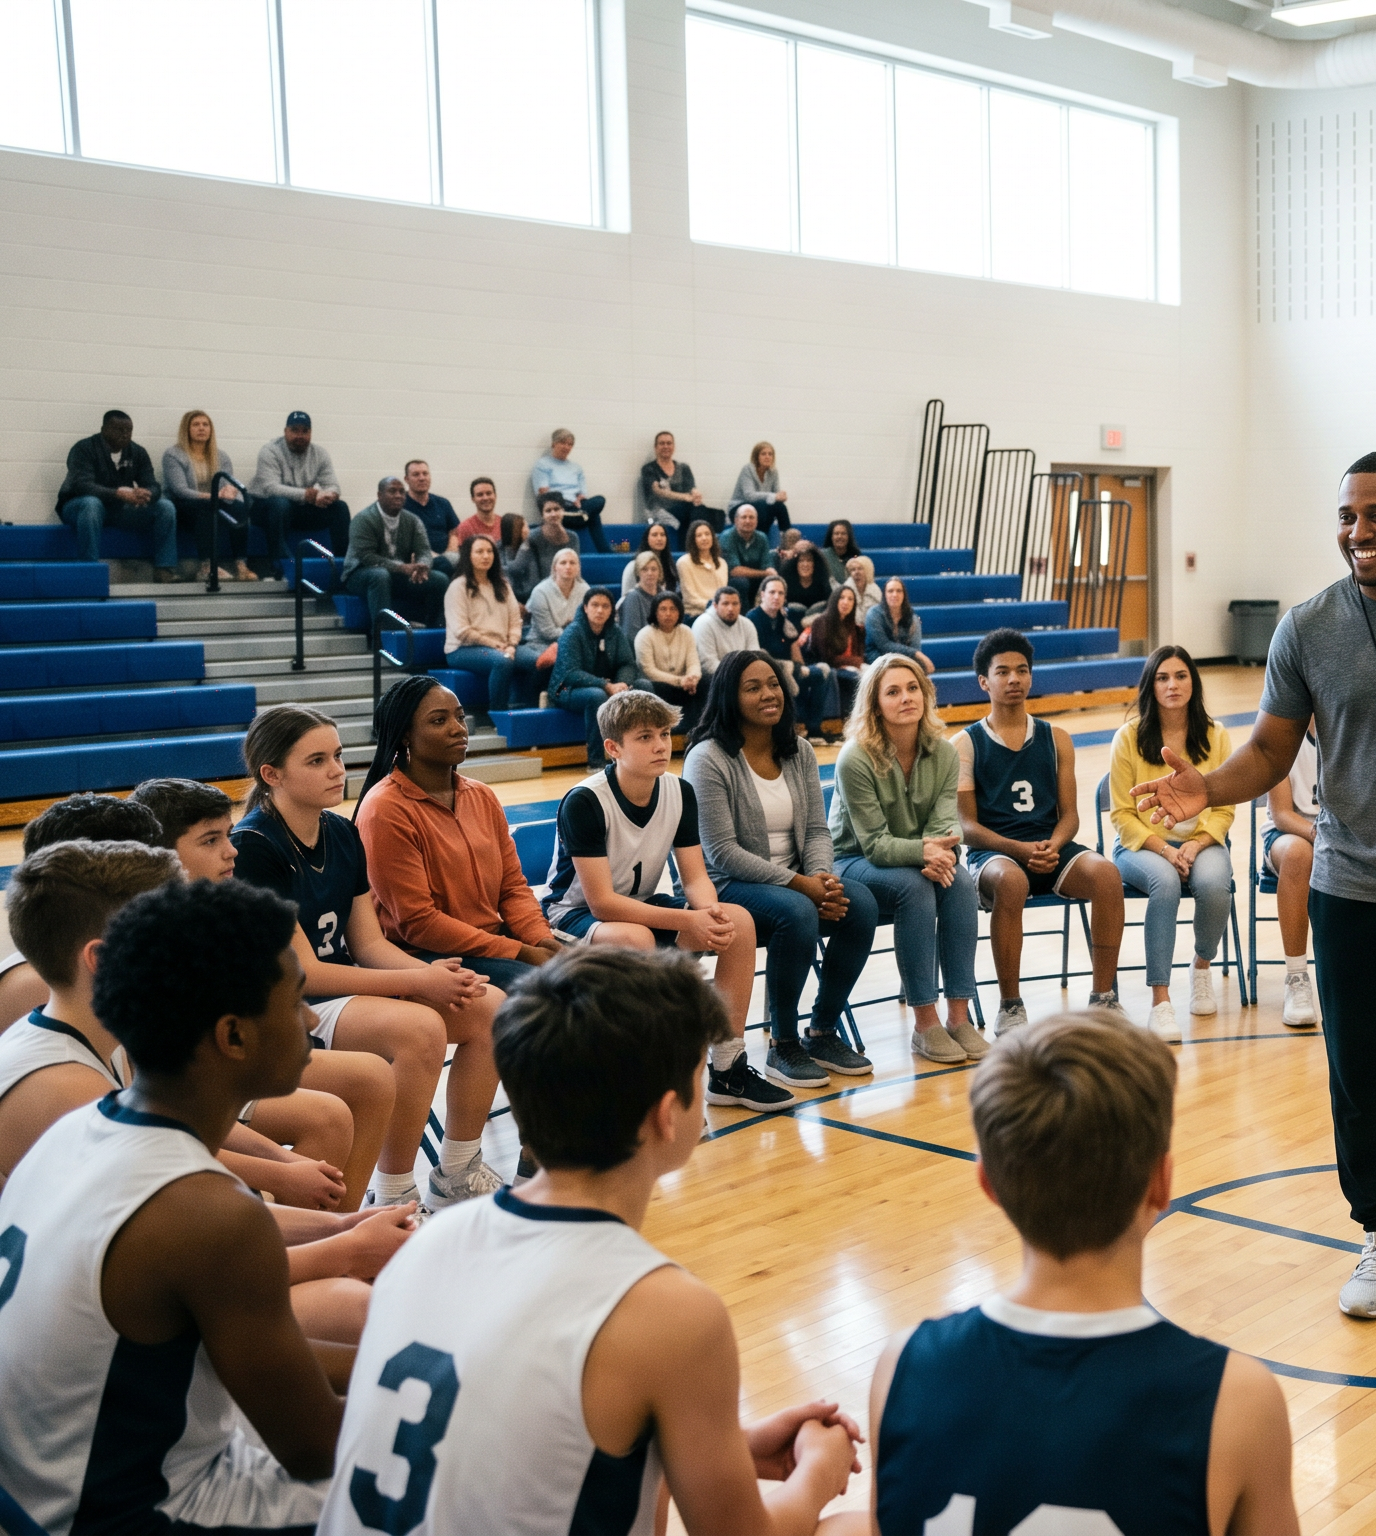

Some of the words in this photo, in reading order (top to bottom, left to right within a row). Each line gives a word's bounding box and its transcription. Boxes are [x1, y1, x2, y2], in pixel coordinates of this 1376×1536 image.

[1011, 780, 1035, 812] 3
[629, 861, 642, 896] 1
[349, 1341, 461, 1536] 3
